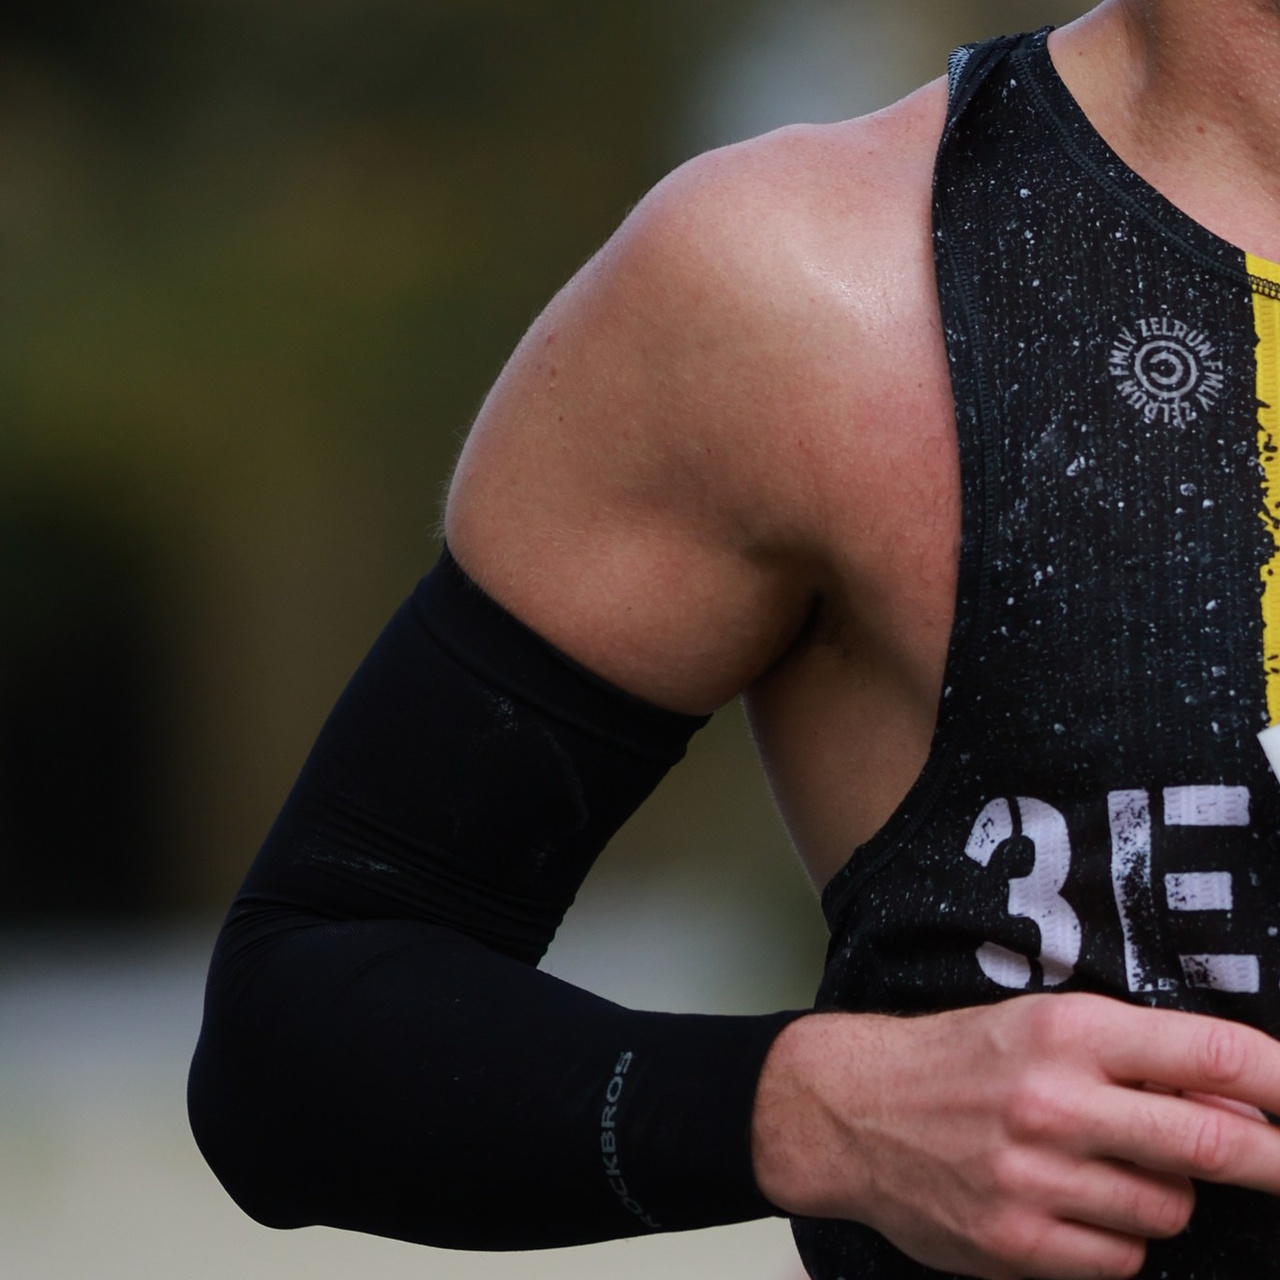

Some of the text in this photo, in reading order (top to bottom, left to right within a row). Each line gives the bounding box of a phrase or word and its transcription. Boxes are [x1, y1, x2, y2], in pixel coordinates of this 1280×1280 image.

[1108, 326, 1137, 376] FMLY
[1136, 317, 1215, 357] ZELRUN
[1195, 361, 1223, 411] FMLY
[601, 1051, 661, 1227] ROCKBROS
